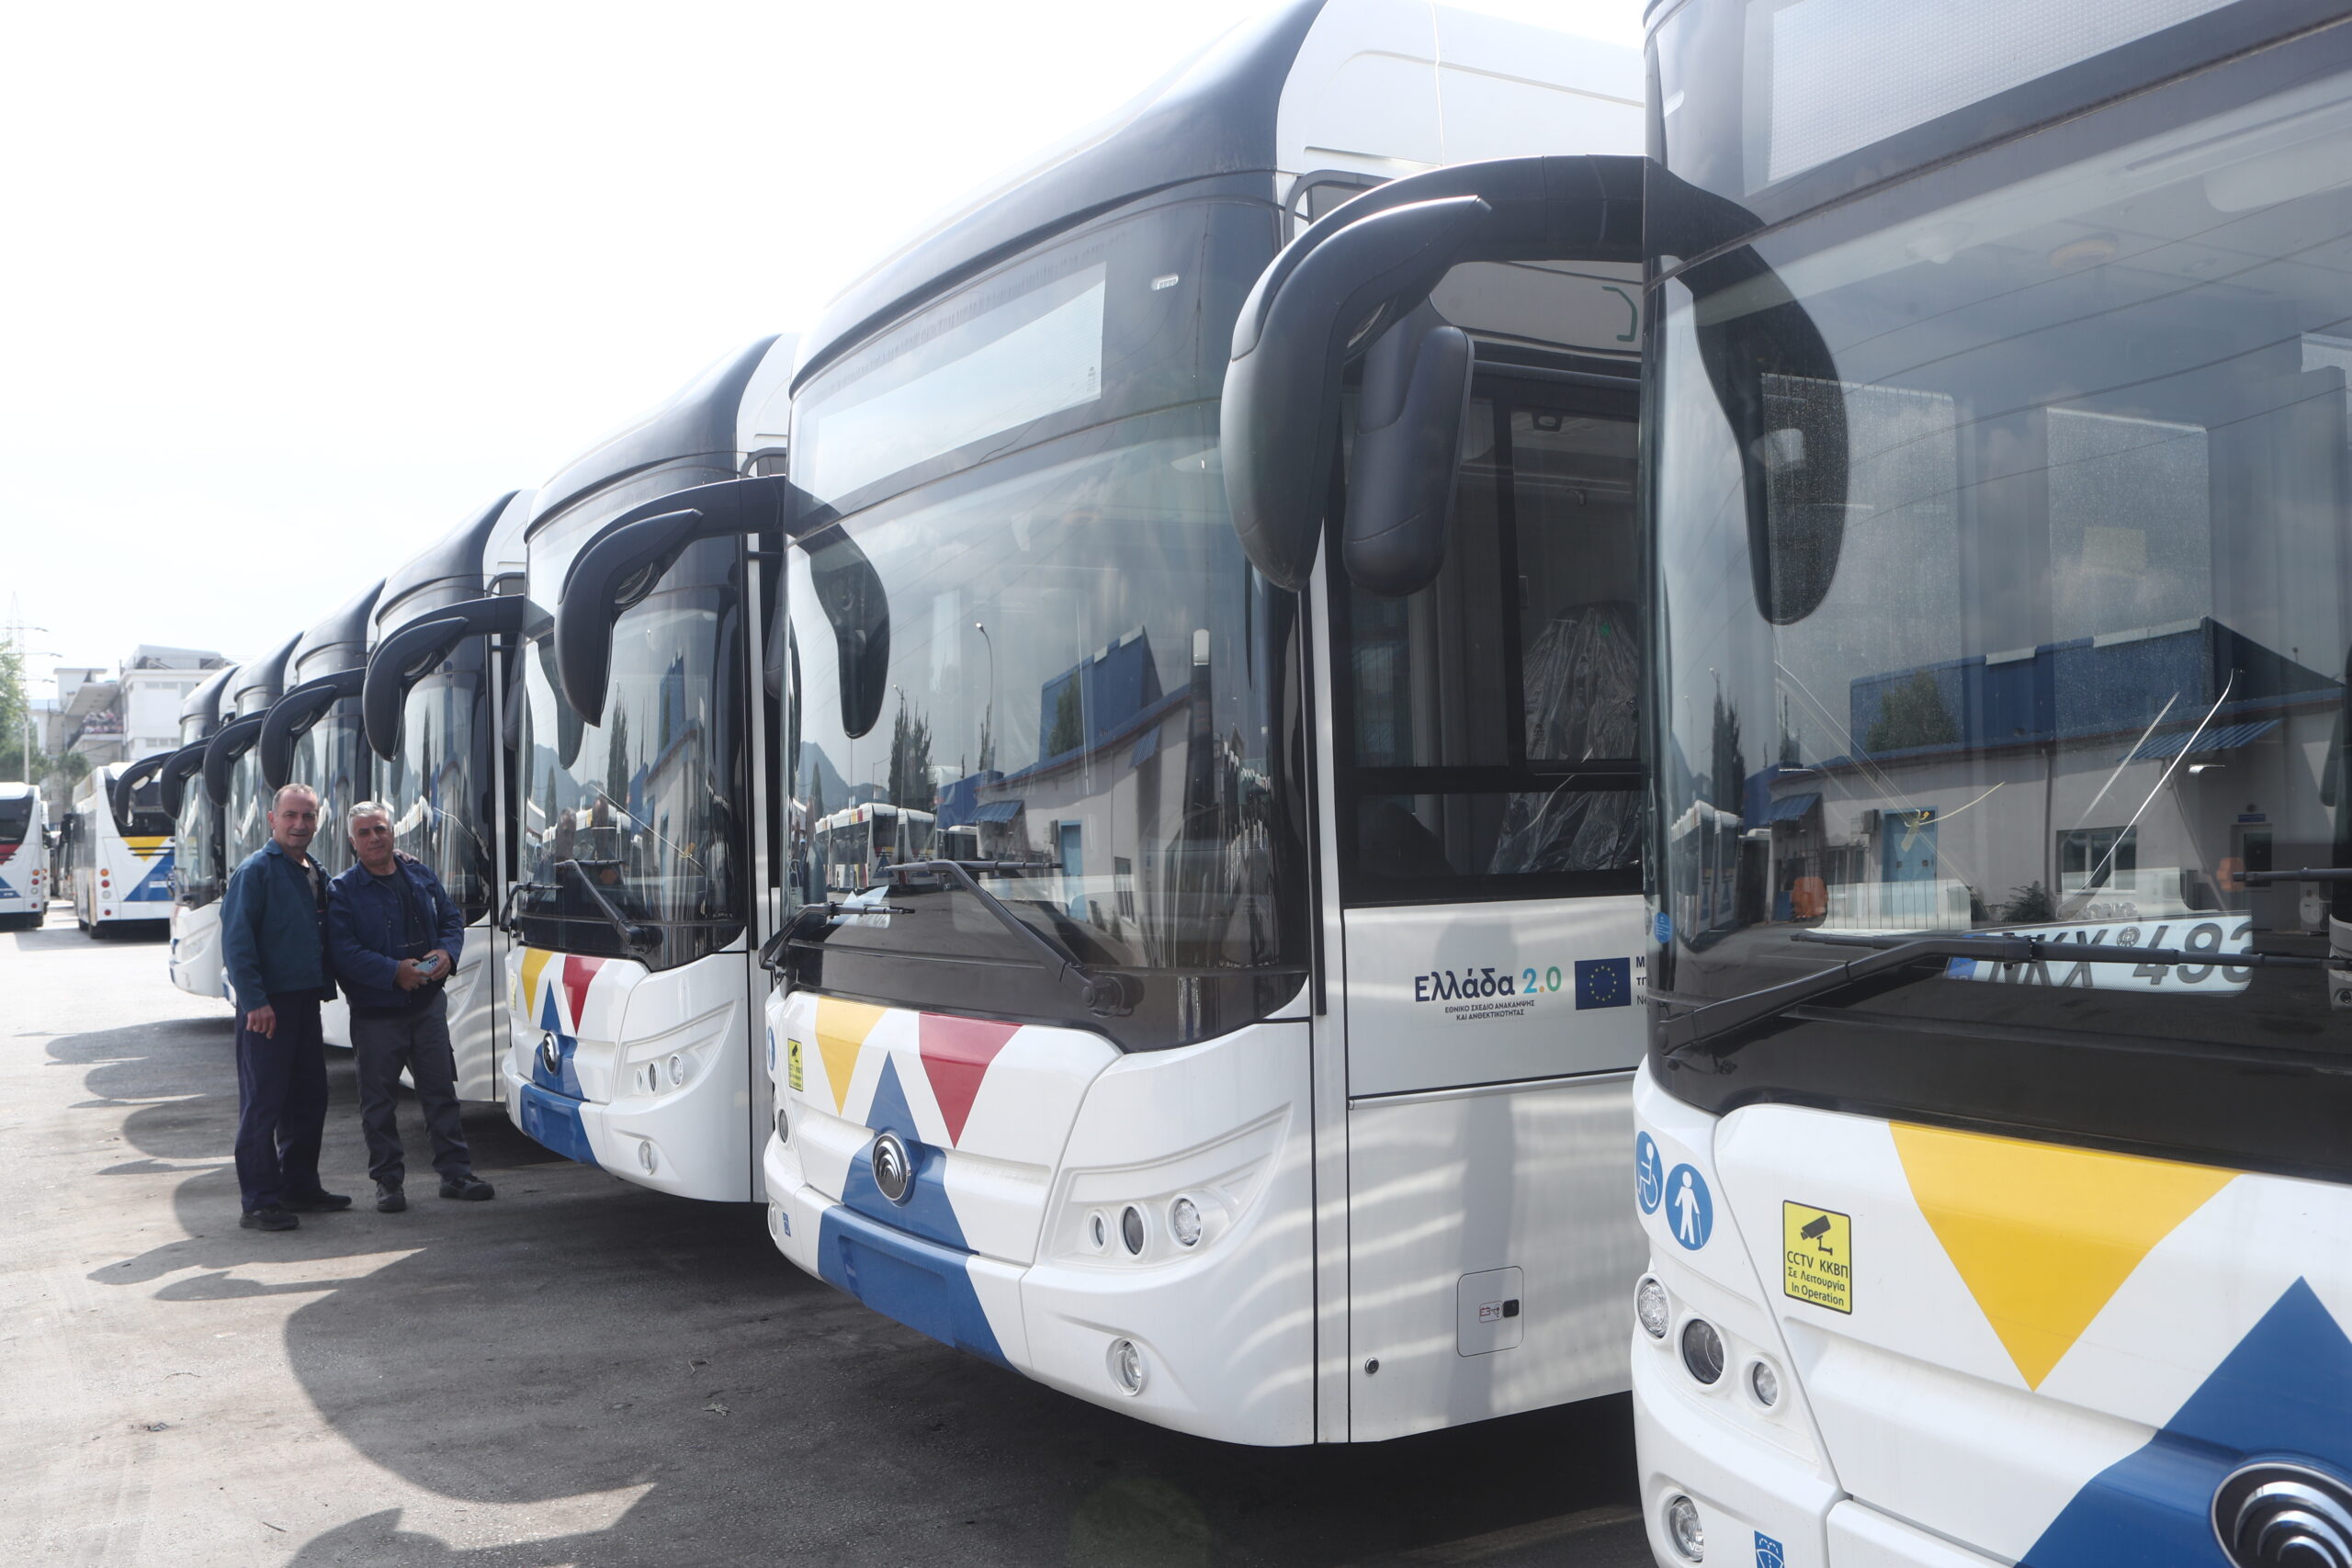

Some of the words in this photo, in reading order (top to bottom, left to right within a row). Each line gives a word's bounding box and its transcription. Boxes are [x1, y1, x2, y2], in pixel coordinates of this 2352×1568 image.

[1415, 967, 1516, 1002] Ελλάδα
[1522, 966, 1562, 994] 2.0
[1444, 1005, 1470, 1014] ΕΘΝΙΚΟ
[1471, 1002, 1494, 1011] ΣΧΕΔΙΟ
[1495, 999, 1535, 1010] ΑΝΑΚΑΜΨΗΣ
[1456, 1012, 1467, 1021] ΚΑΙ
[1468, 1009, 1525, 1021] ΑΝΘΕΚΤΙΚΟΤΗΤΑΣ
[1787, 1250, 1814, 1269] CCTV
[1820, 1259, 1849, 1279] ΚΚΒΠ
[1788, 1266, 1797, 1278] Σε
[1801, 1270, 1846, 1292] Λειτουργία
[1792, 1281, 1800, 1293] In
[1801, 1284, 1845, 1306] Operation
